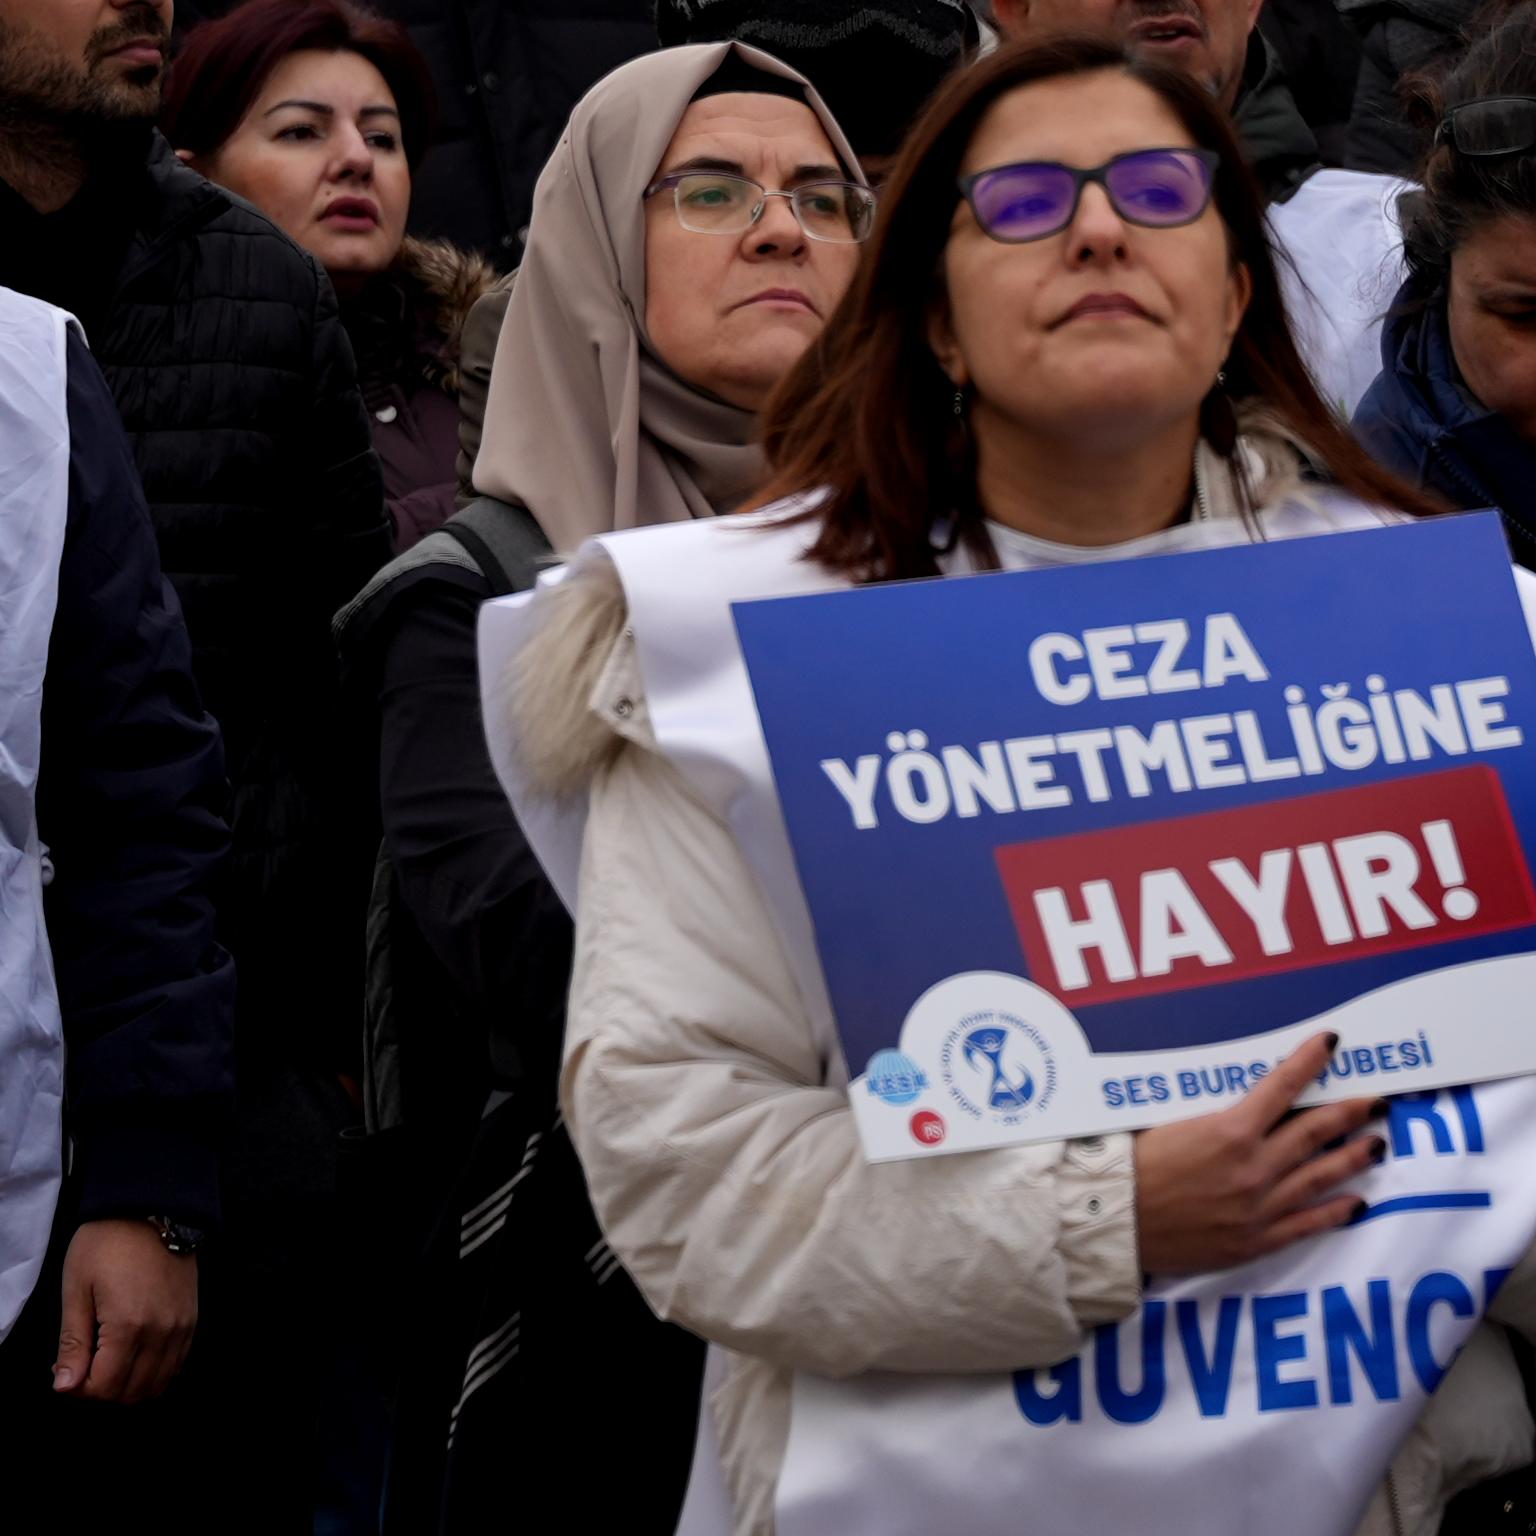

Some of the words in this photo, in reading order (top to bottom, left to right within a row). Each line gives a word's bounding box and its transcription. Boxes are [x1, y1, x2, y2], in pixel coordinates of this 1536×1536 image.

[1027, 613, 1269, 705] CEZA
[821, 675, 1523, 829] YÖNETMELİĞİNE
[1031, 818, 1480, 991] HAYIR!
[1101, 1072, 1171, 1108] SES
[1176, 1056, 1287, 1100] BURS
[1013, 1267, 1511, 1425] GÜVENC
